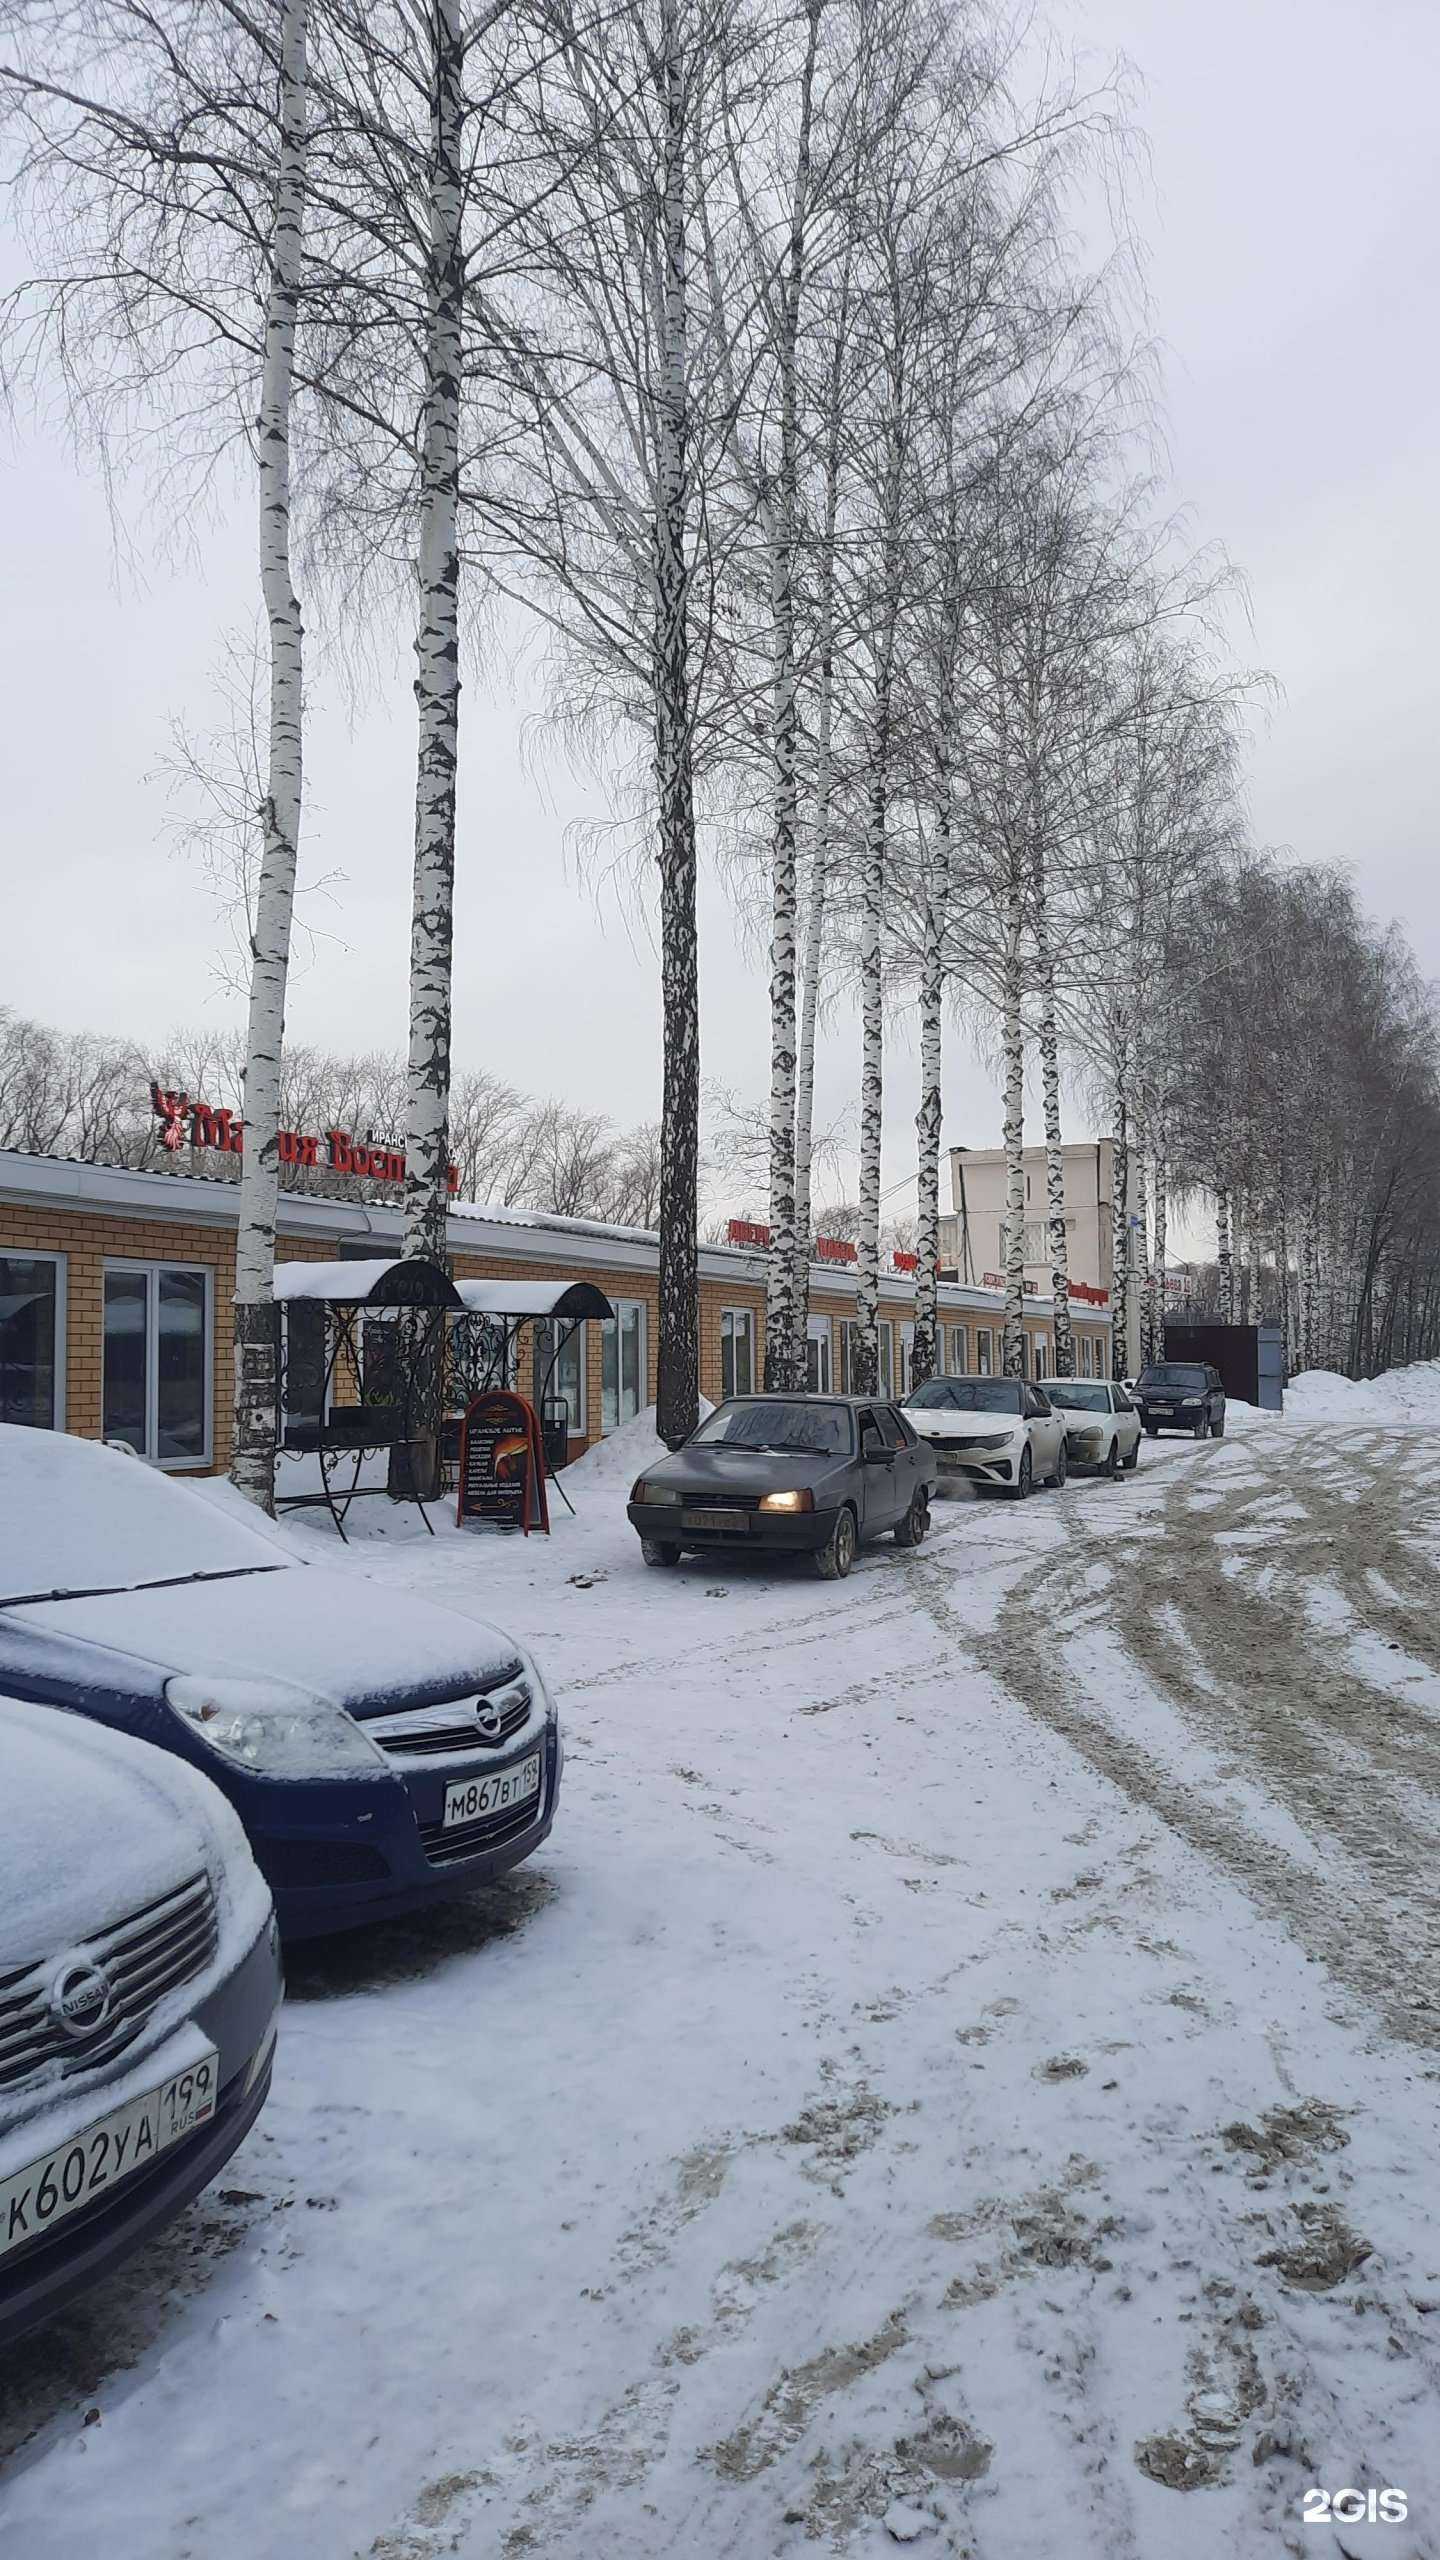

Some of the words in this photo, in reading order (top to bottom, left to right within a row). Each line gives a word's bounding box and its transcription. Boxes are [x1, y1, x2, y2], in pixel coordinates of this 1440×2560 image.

[371, 1129, 407, 1149] ИРАНС
[62, 1983, 110, 2014] NISSAN
[163, 2065, 210, 2121] 199
[170, 2111, 195, 2136] RUS
